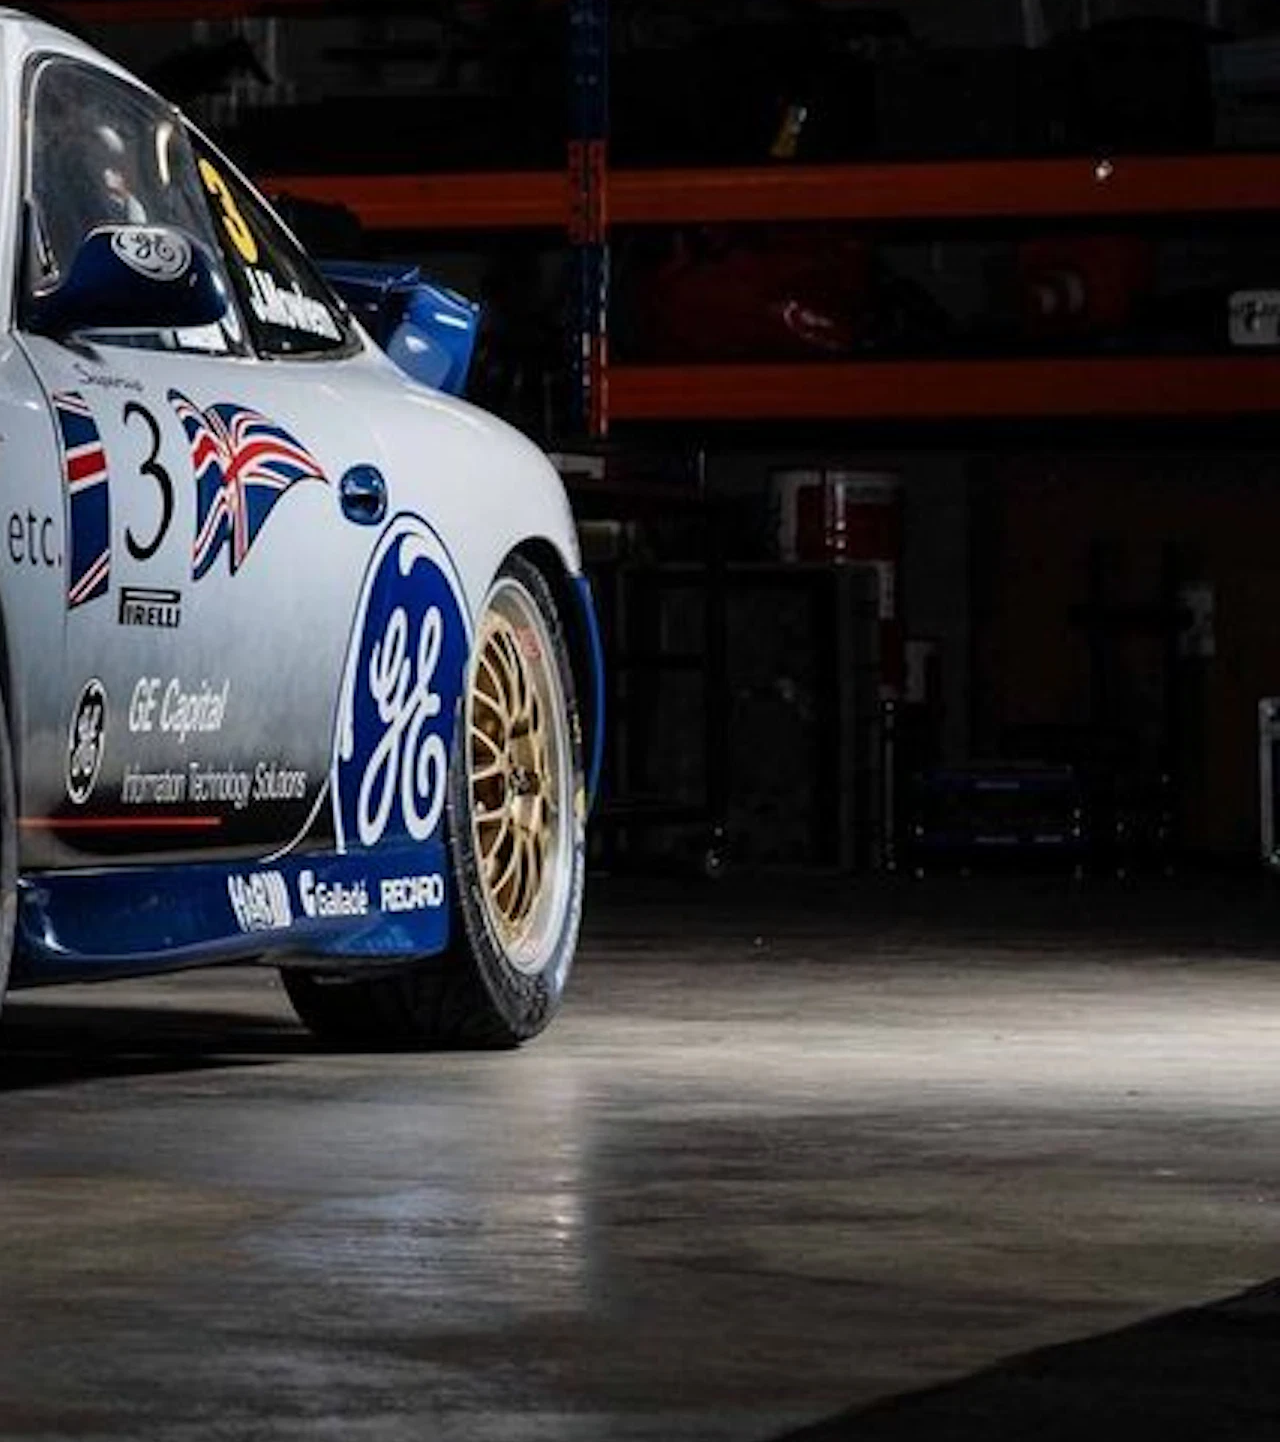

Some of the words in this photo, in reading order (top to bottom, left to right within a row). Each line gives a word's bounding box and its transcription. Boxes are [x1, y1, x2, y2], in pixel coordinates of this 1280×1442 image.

[197, 157, 259, 265] 3
[121, 400, 175, 563] 3
[7, 507, 63, 566] etc.
[118, 586, 182, 628] PIRELLI
[128, 676, 162, 732] GE
[159, 677, 231, 743] Capital
[380, 873, 444, 912] RECARO
